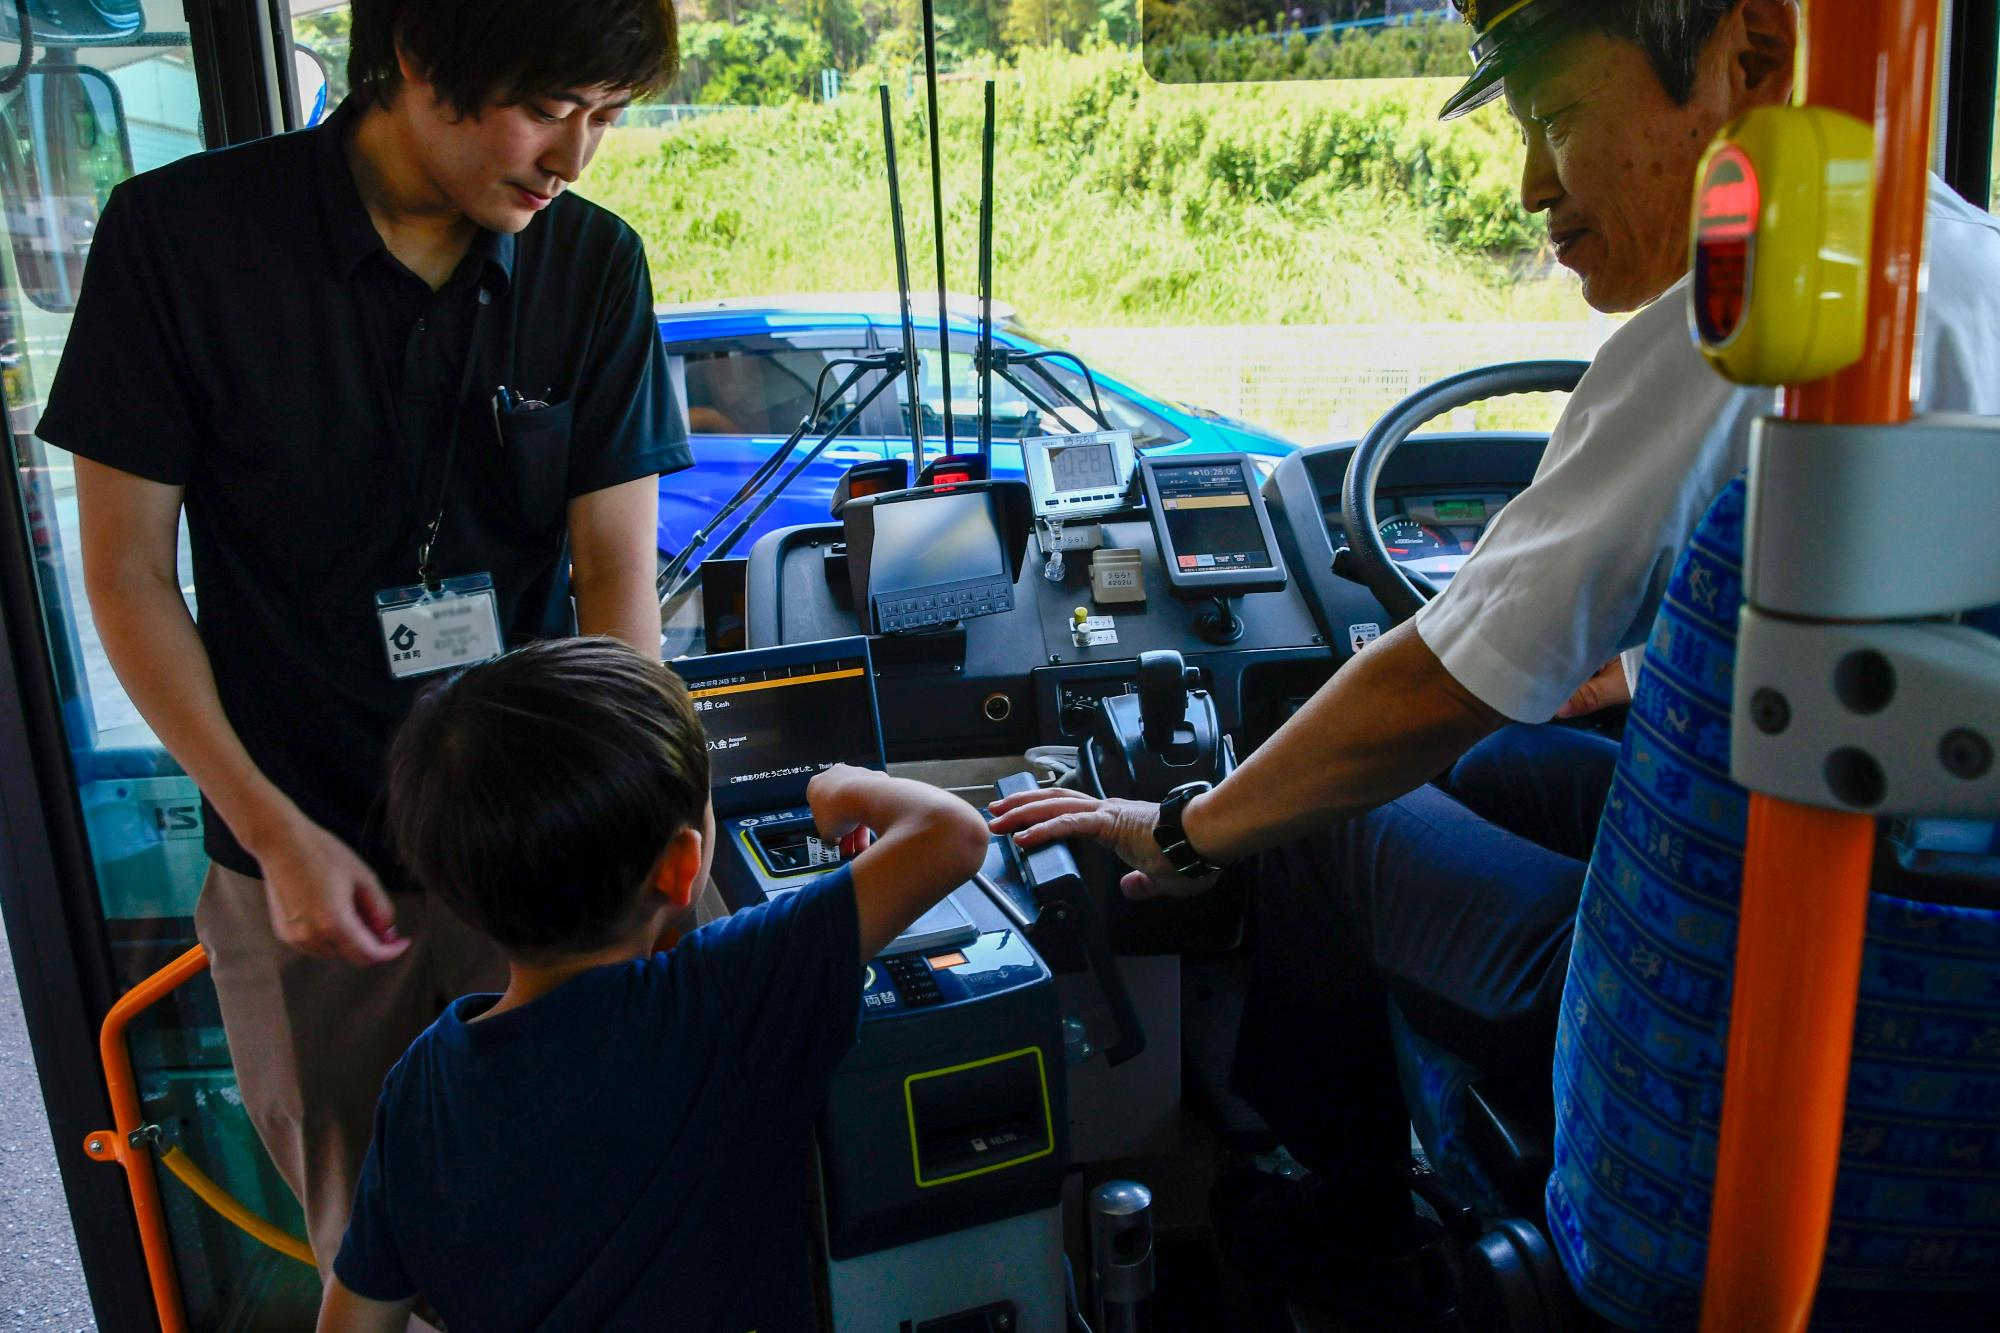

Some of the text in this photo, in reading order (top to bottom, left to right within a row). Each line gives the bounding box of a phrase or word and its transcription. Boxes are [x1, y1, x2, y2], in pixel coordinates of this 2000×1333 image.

[1199, 468, 1237, 476] 10:28:06
[1417, 530, 1423, 538] 3
[714, 700, 730, 709] Cash
[706, 739, 727, 751] 入金
[863, 991, 896, 1008] 両替
